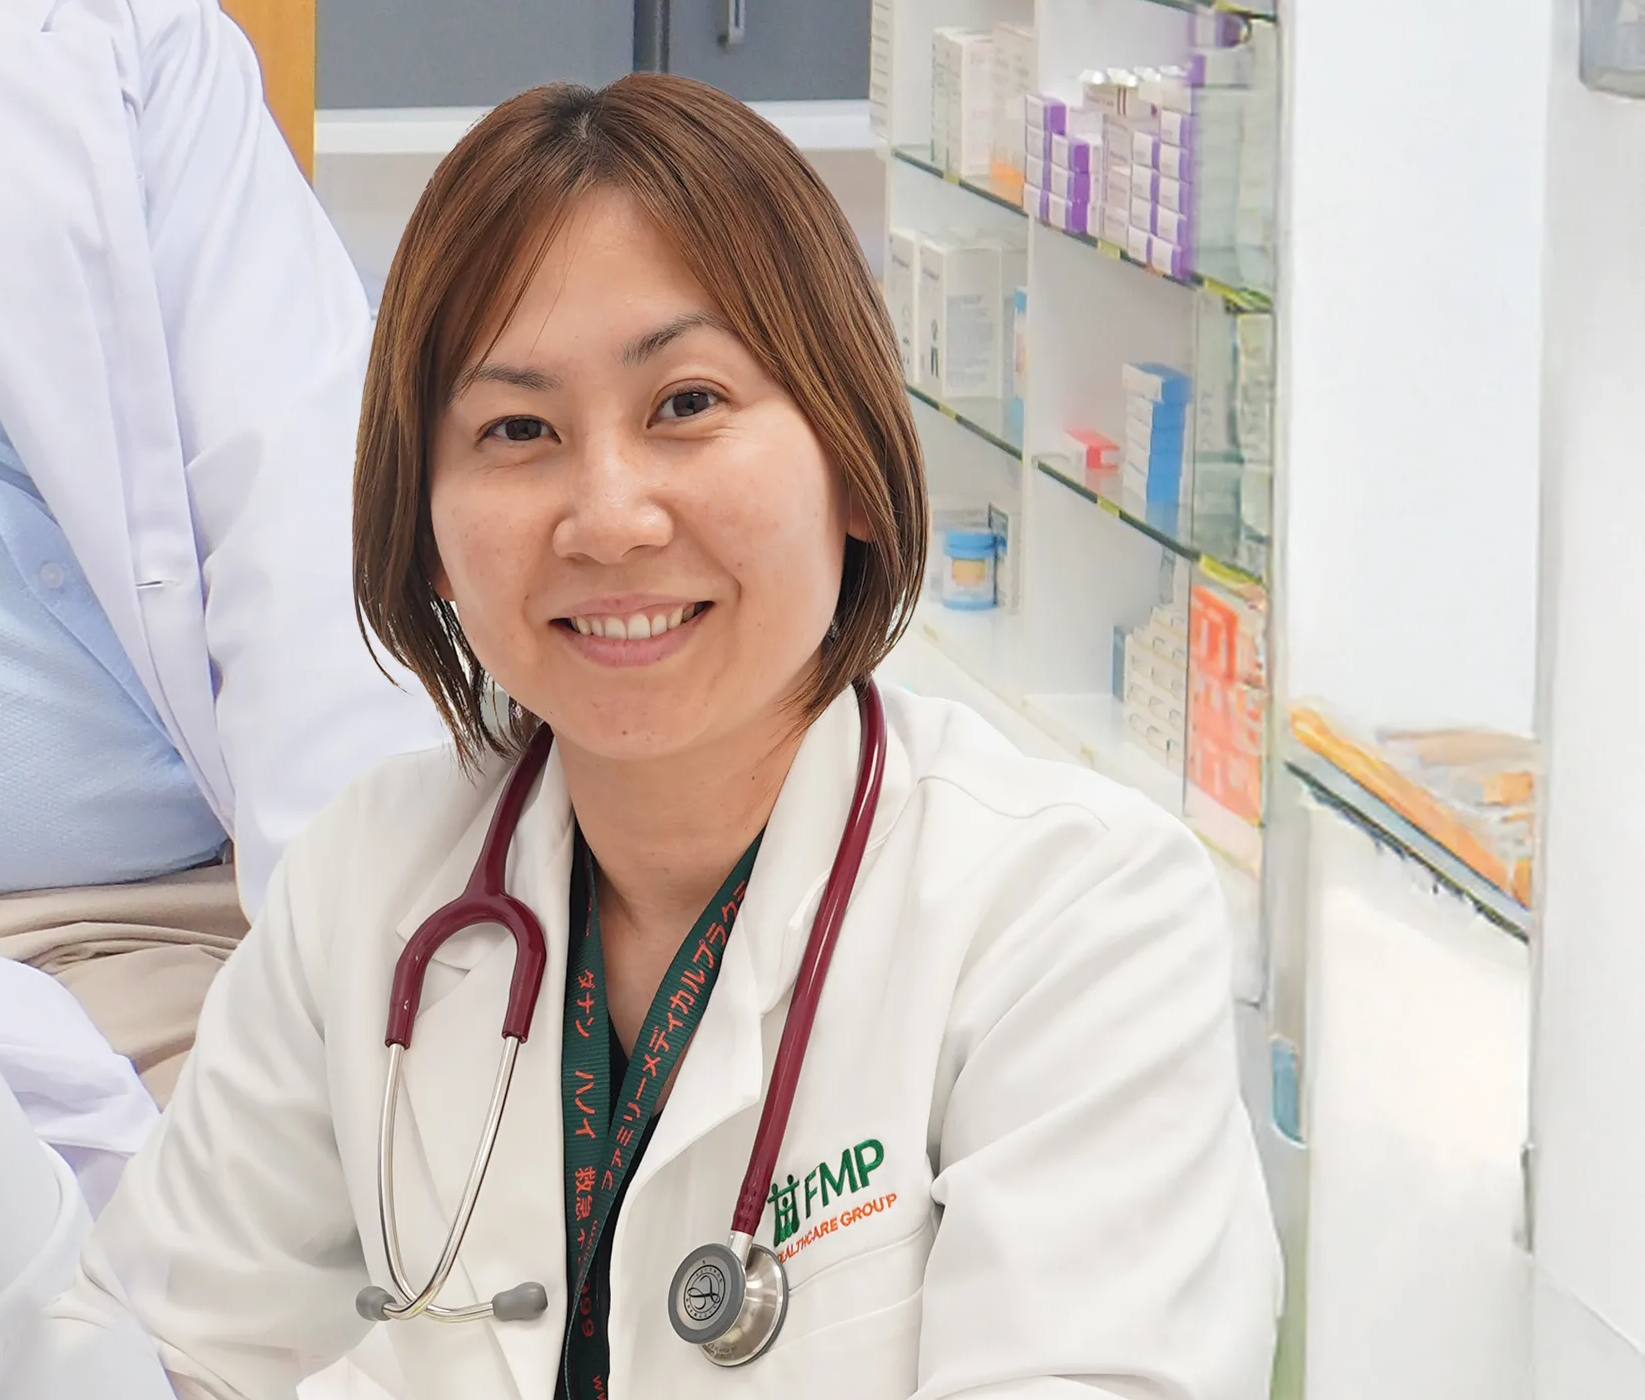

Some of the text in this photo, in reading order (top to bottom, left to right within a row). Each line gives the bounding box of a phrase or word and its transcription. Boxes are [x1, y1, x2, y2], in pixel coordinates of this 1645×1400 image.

[575, 969, 595, 1039] ダナン
[574, 1069, 596, 1140] ハノイ
[574, 1166, 597, 1222] 救急
[804, 1139, 885, 1220] FMP
[777, 1192, 897, 1265] EALTHCARE GROUP
